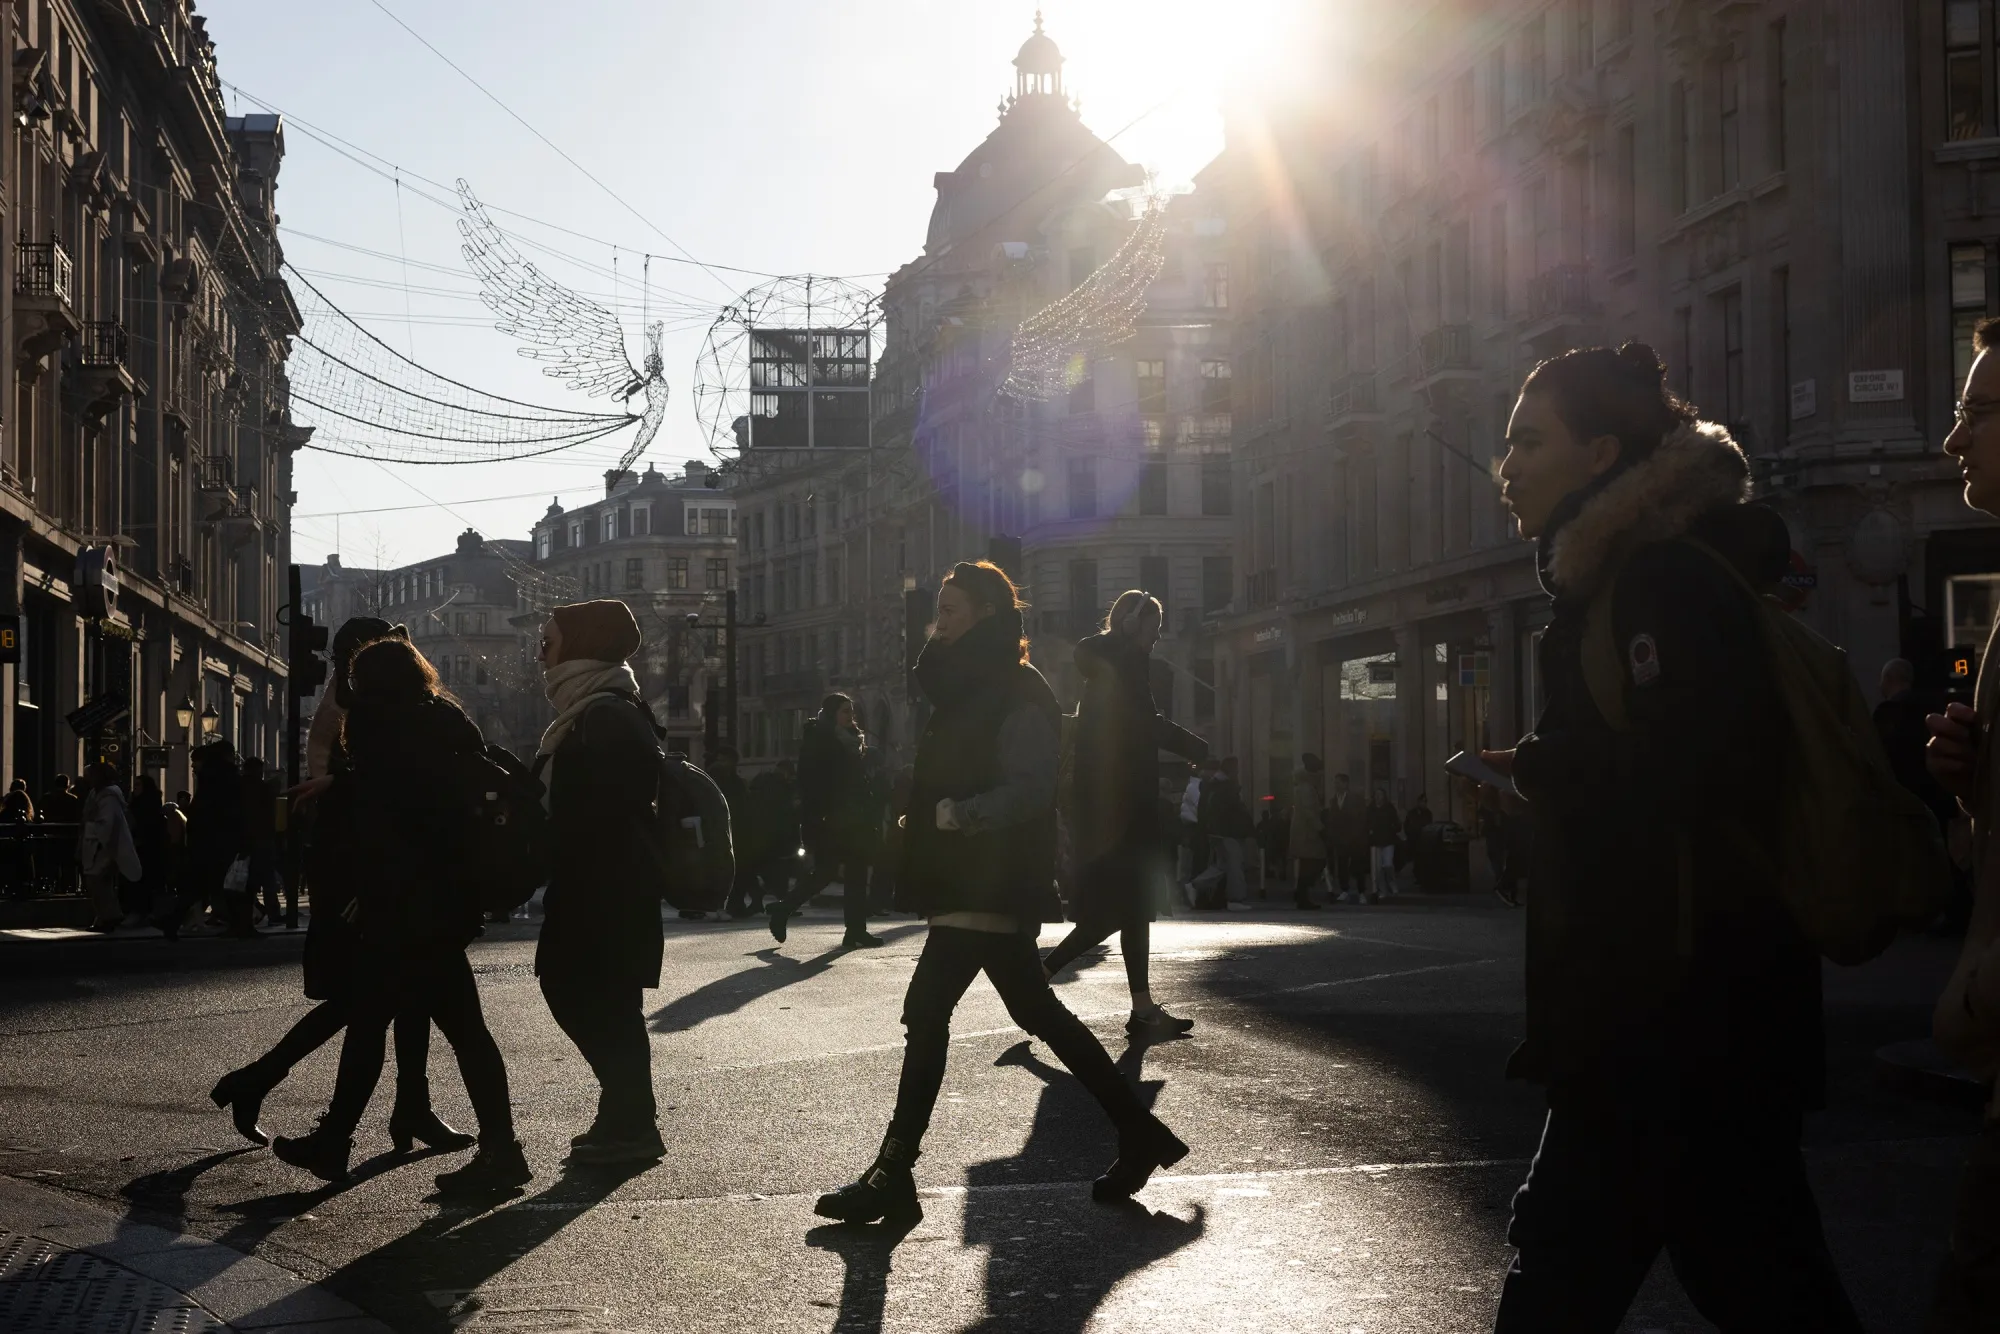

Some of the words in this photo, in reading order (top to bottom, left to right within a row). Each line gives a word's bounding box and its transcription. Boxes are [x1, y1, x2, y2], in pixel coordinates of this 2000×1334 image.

[1854, 374, 1886, 383] OXFORD
[1854, 383, 1884, 392] CIRCUS
[1886, 382, 1899, 391] W1
[1, 629, 15, 649] 18
[1954, 659, 1969, 676] 18
[99, 743, 119, 753] KO
